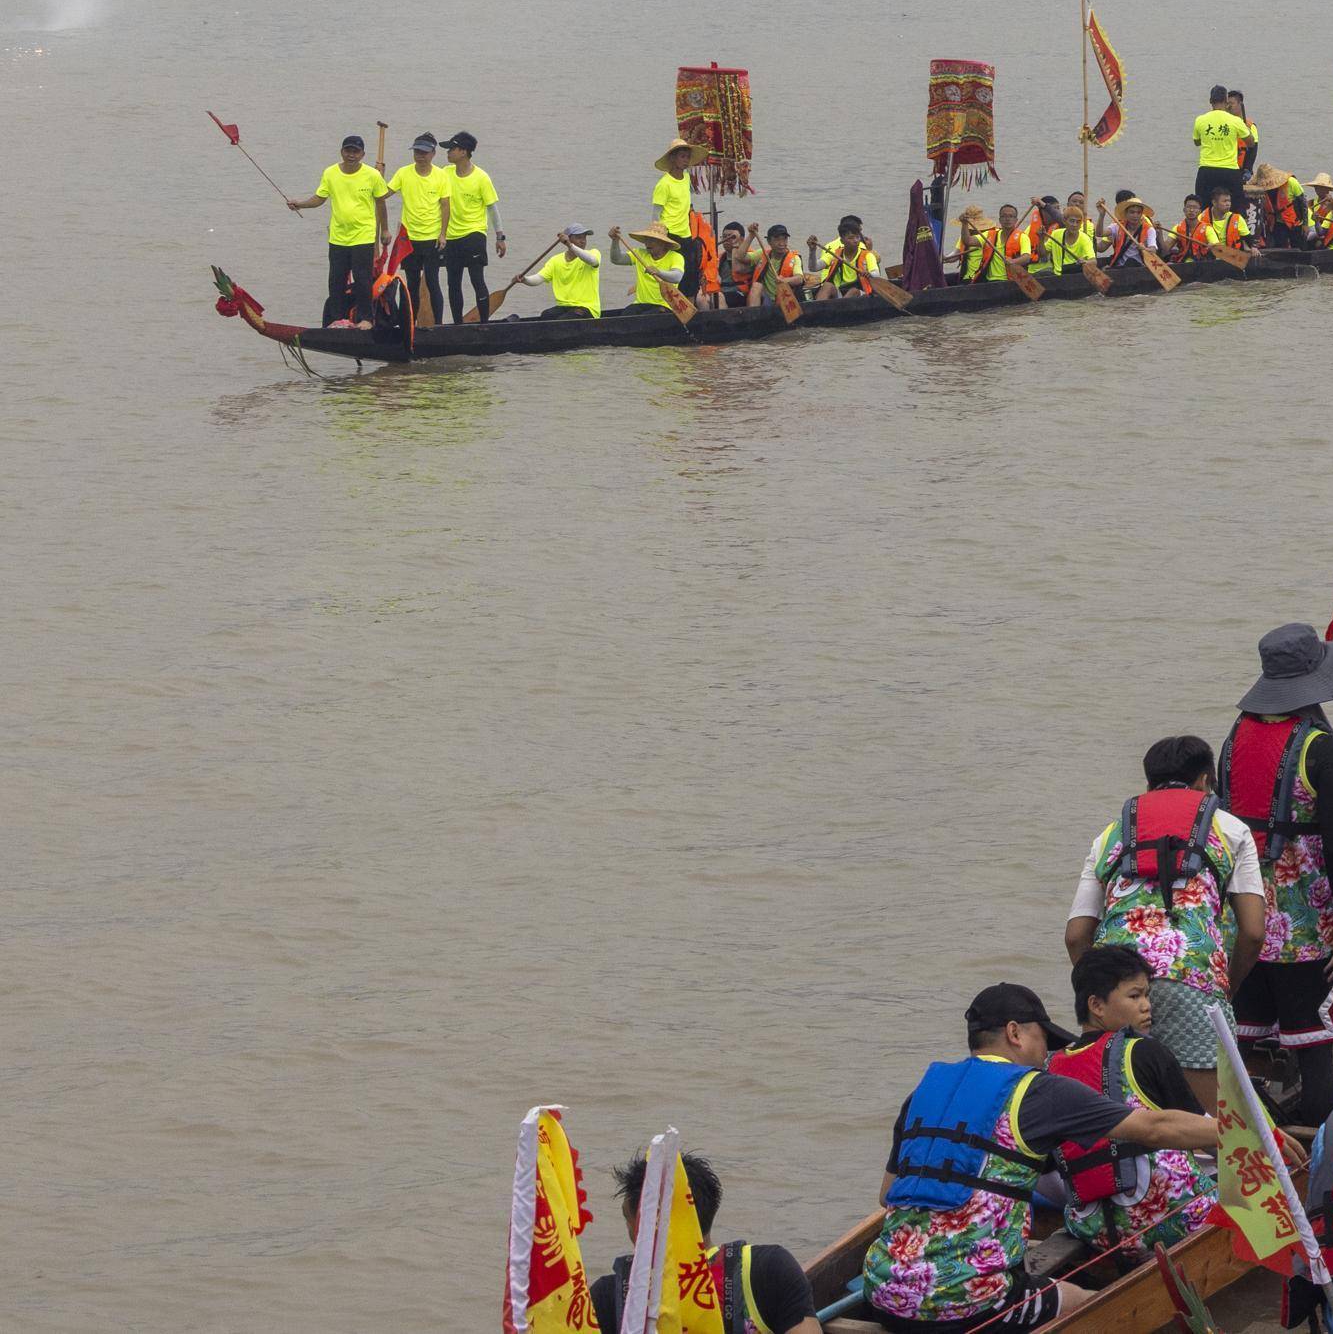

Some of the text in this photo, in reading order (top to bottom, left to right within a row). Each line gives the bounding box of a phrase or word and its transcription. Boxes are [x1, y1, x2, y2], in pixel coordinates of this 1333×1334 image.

[1205, 123, 1230, 137] 大塘
[725, 1276, 733, 1320] JUST GO
